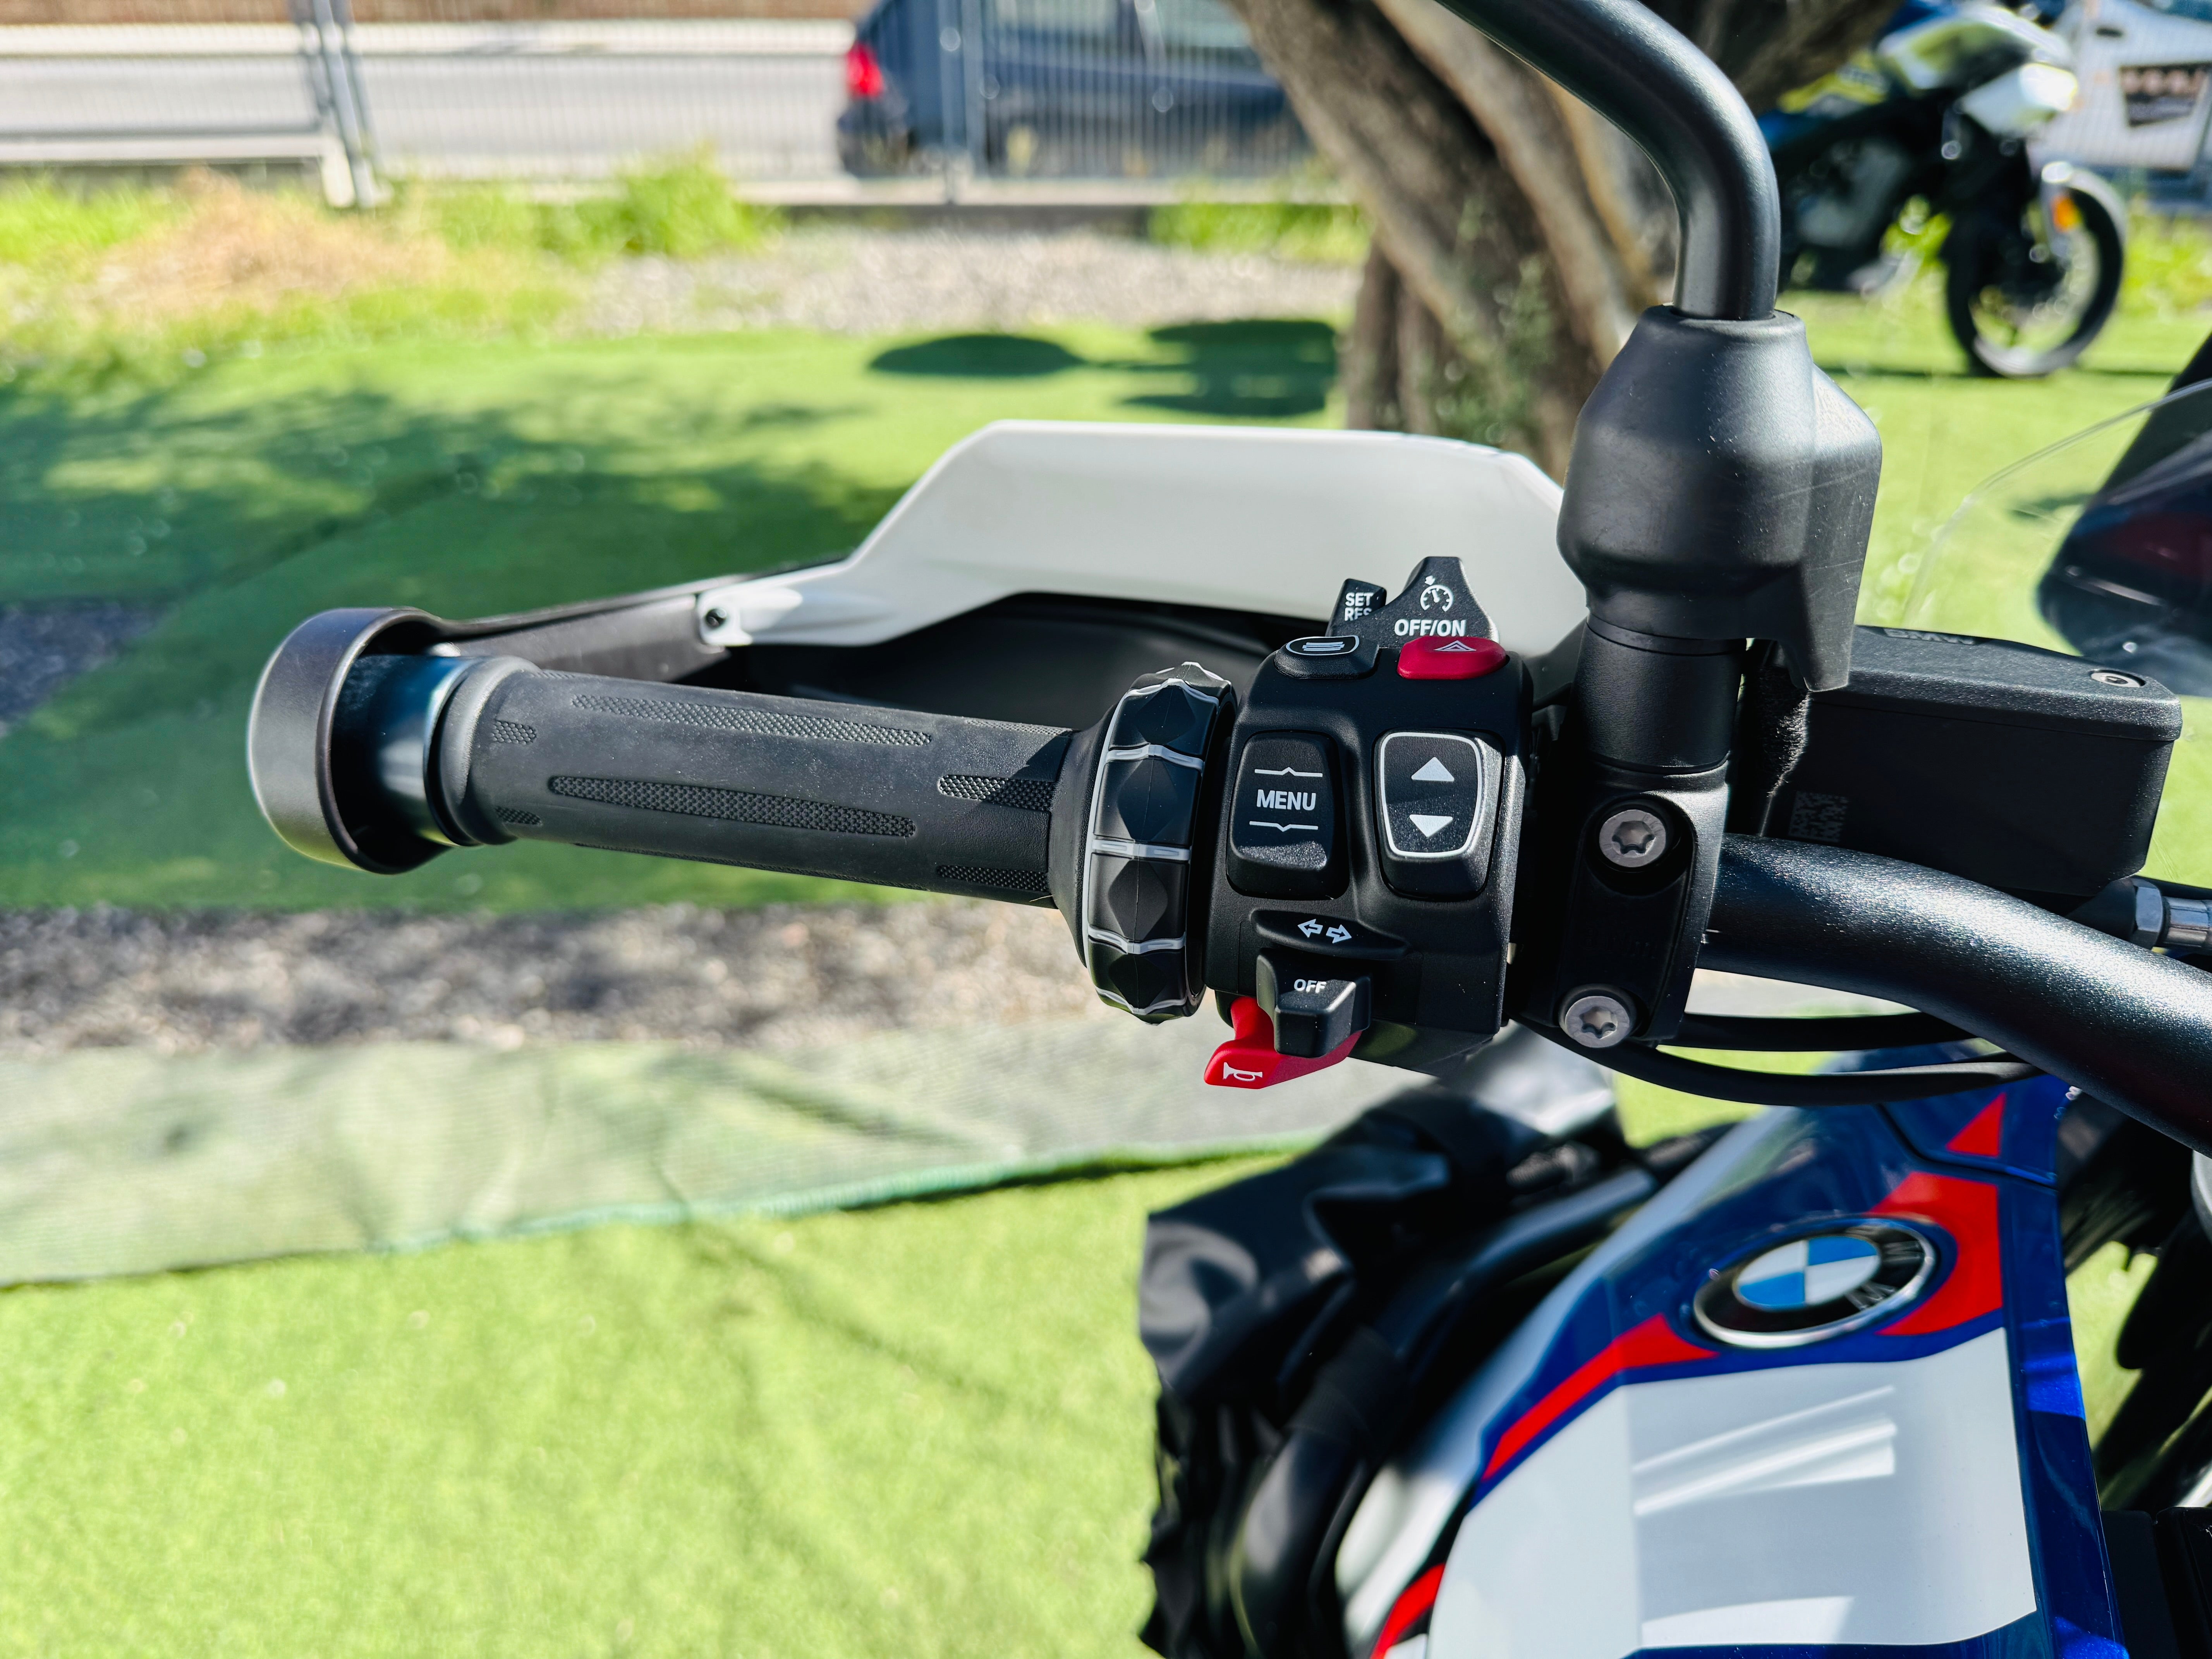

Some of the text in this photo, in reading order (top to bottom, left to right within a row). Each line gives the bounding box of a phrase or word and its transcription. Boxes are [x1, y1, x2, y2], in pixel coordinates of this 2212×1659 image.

[1345, 592, 1374, 606] SET
[1394, 619, 1466, 636] OFF/ON
[1257, 789, 1316, 811] MENU
[1294, 979, 1327, 993] OFF
